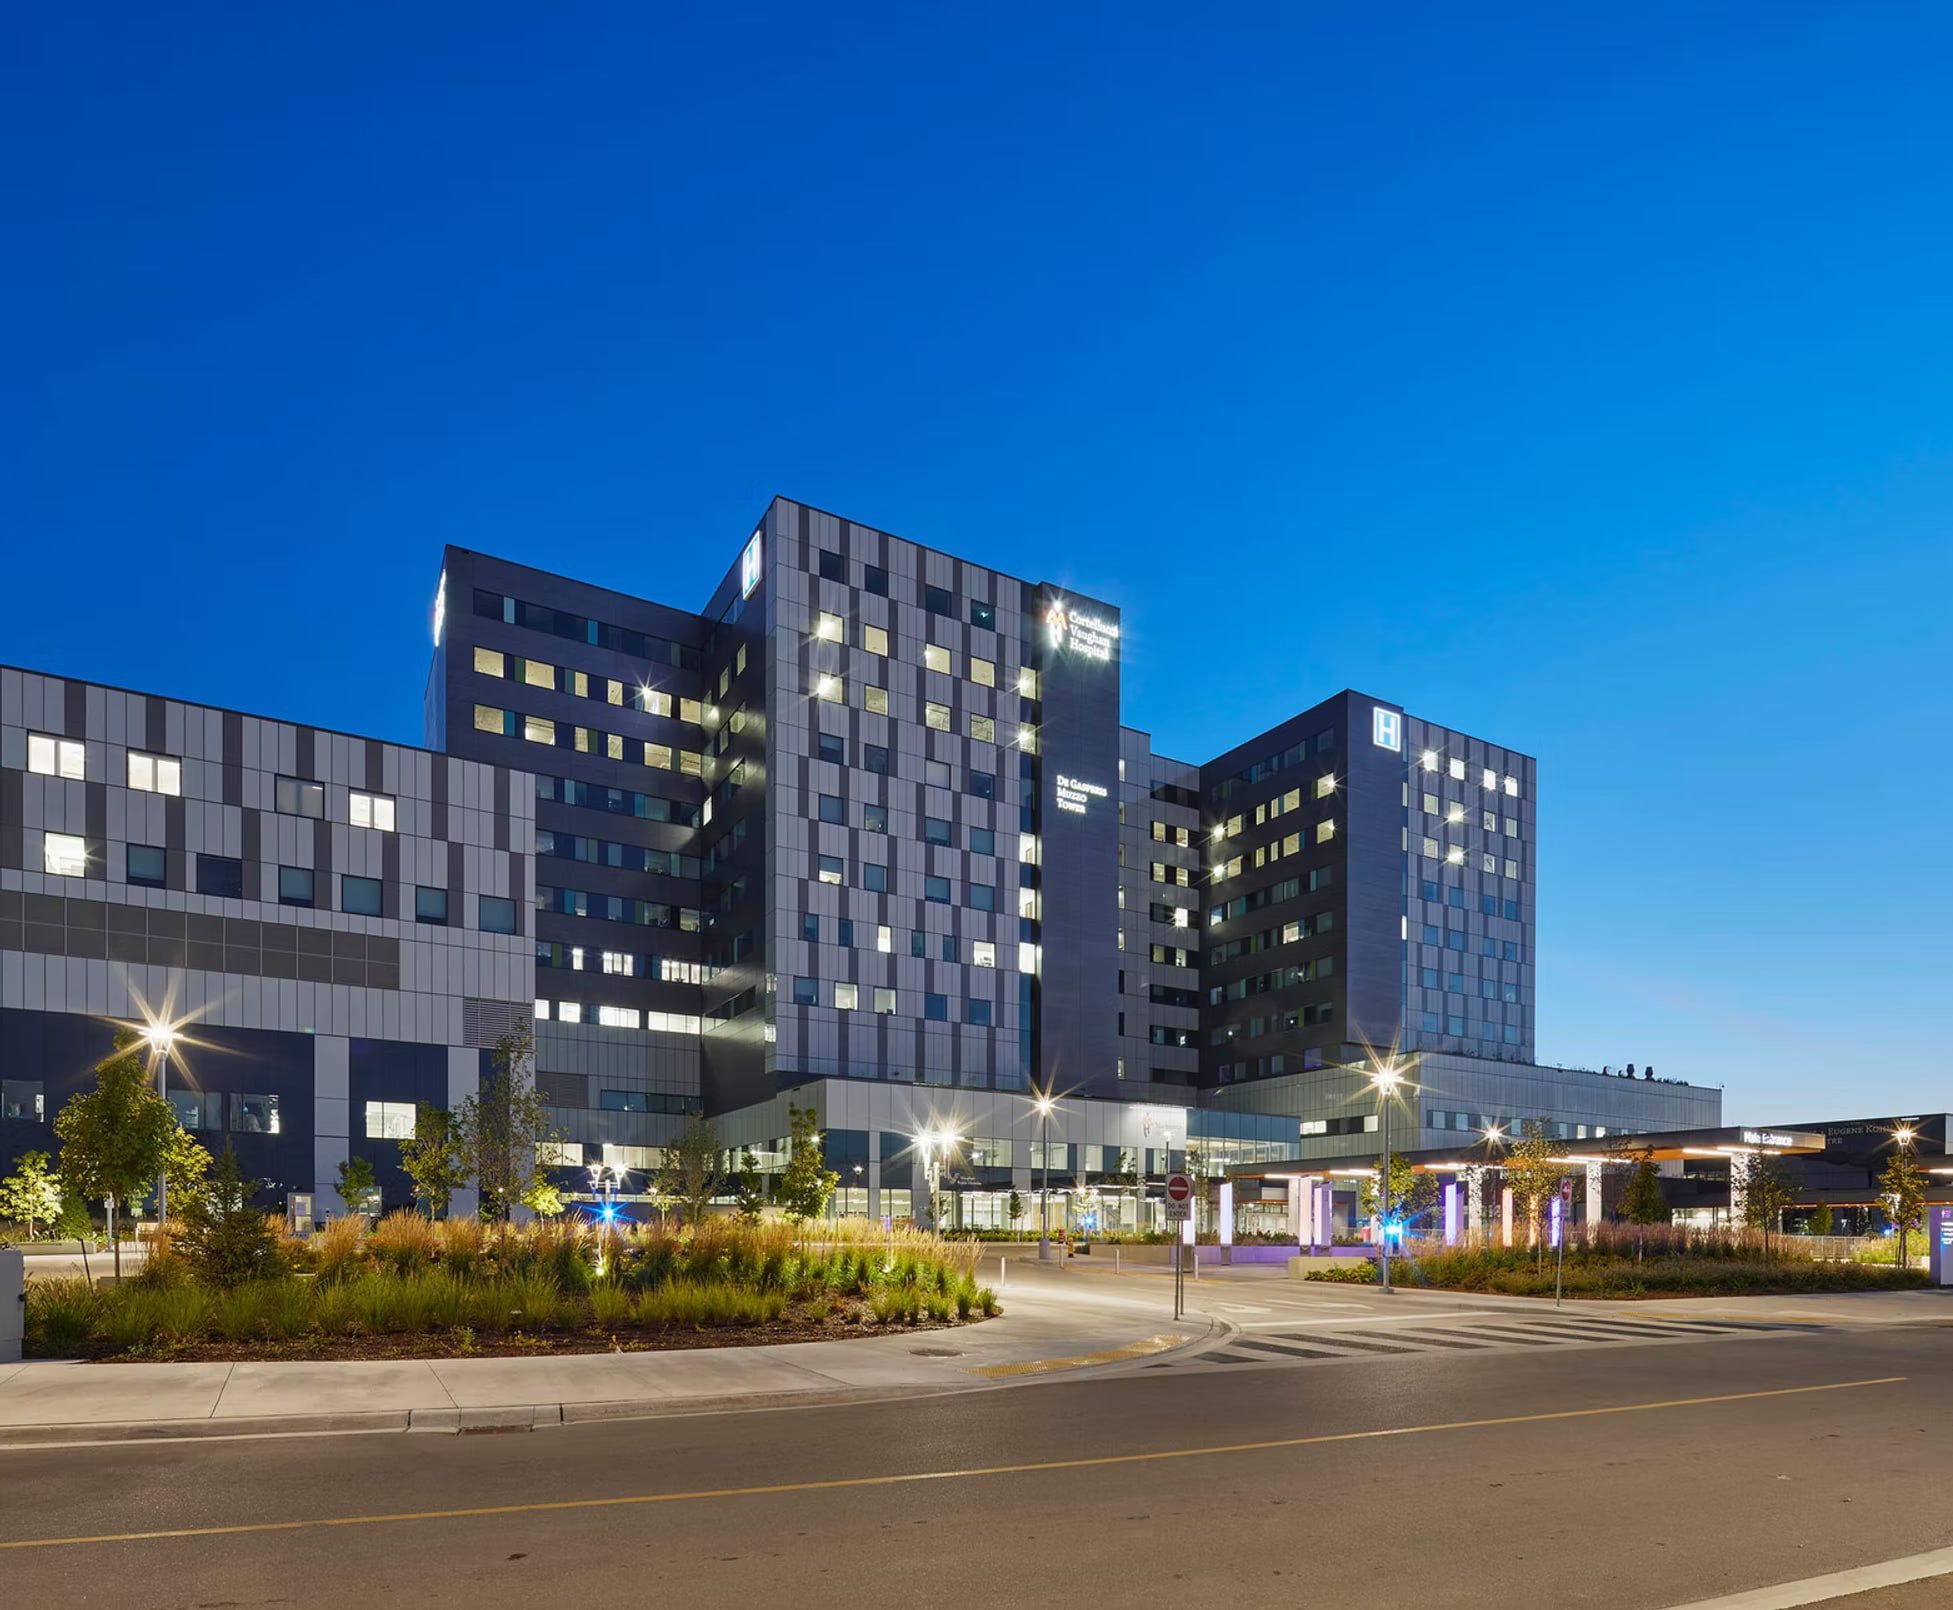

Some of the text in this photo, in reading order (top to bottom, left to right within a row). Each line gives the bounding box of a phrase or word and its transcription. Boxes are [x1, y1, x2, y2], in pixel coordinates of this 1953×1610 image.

[1069, 624, 1110, 648] Vaughan
[1070, 637, 1109, 660] Hospital
[1379, 712, 1396, 747] H
